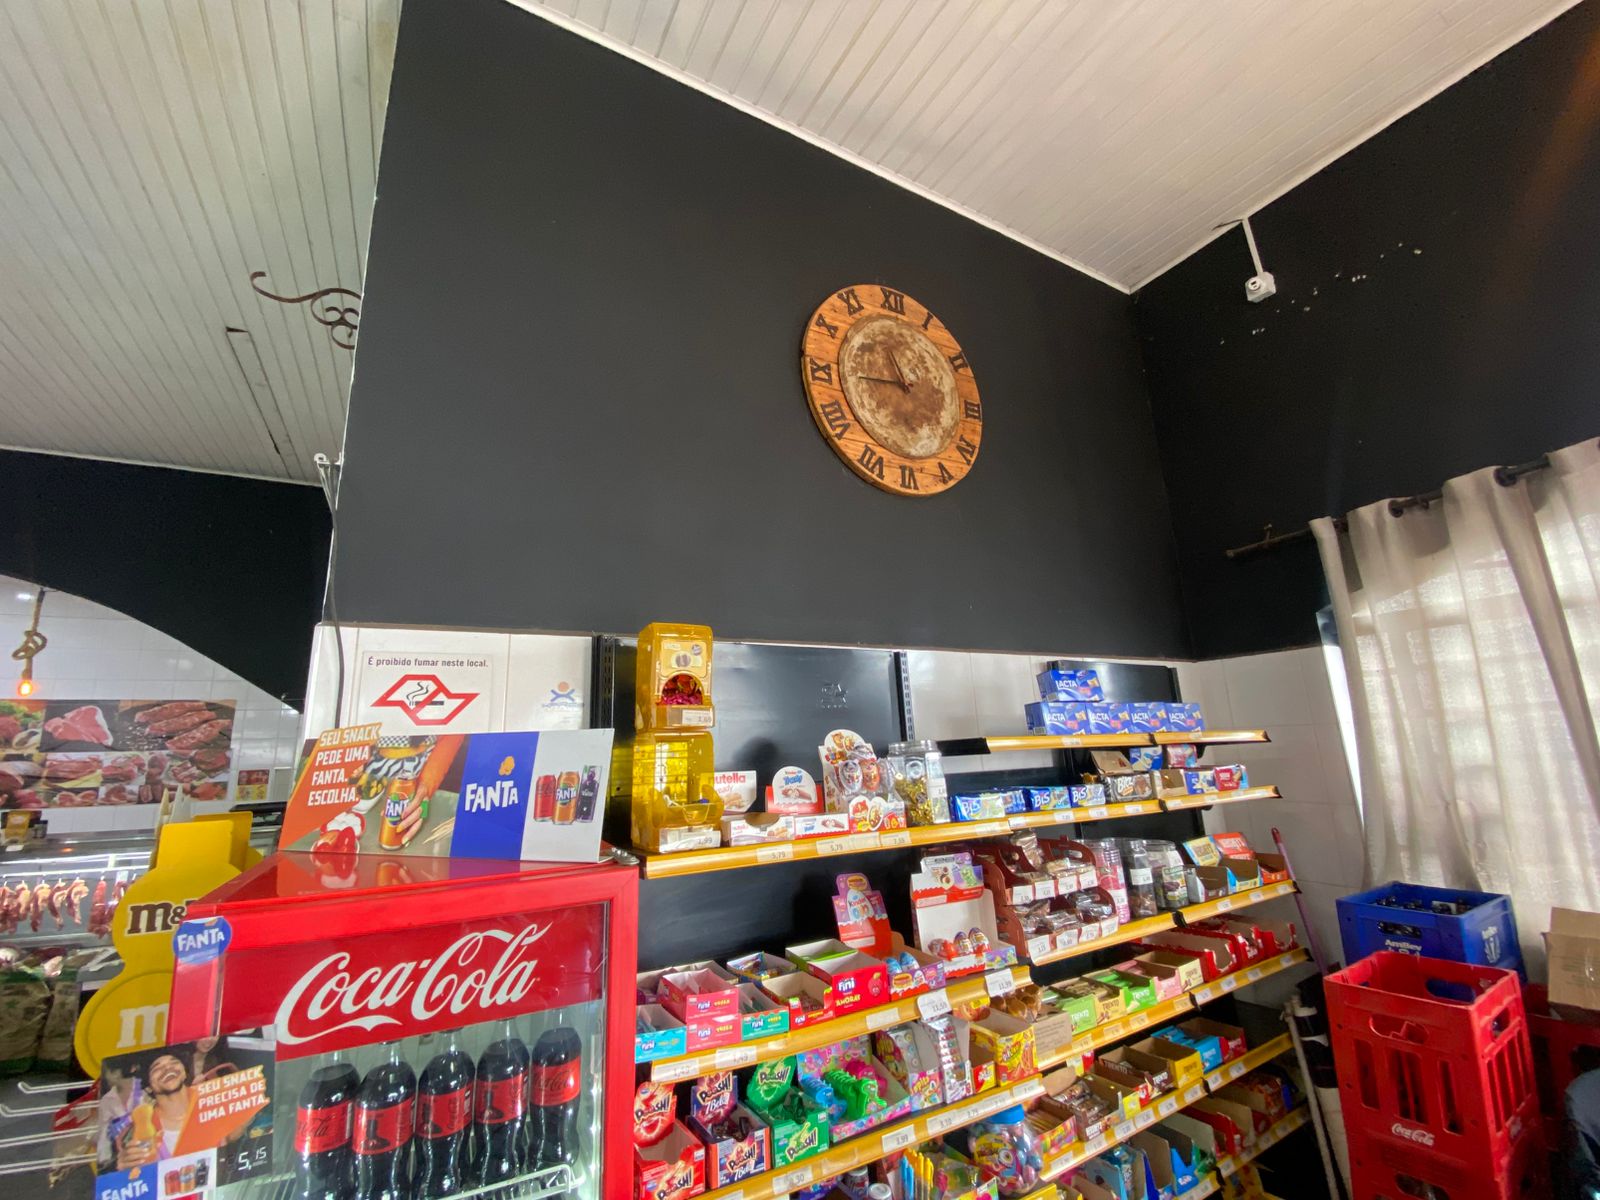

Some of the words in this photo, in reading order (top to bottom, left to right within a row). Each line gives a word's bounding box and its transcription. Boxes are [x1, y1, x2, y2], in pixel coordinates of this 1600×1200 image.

[838, 288, 864, 316] XI
[880, 287, 905, 315] XII
[816, 313, 839, 338] X
[810, 357, 833, 385] IX
[949, 351, 969, 372] II
[857, 444, 885, 481] VII
[937, 461, 954, 485] V
[899, 464, 920, 490] VI
[367, 656, 374, 666] É
[376, 657, 412, 667] proibido
[414, 658, 439, 667] fumar
[441, 659, 465, 668] neste
[467, 659, 489, 668] local.
[1055, 679, 1078, 690] LACTA
[1045, 713, 1066, 722] LACTA
[1090, 712, 1110, 722] LACTA
[1131, 712, 1149, 722] LACTA
[1169, 712, 1186, 722] LACTA
[319, 730, 340, 747] SEU
[342, 725, 380, 745] SNACK
[315, 749, 343, 766] PEDE
[344, 746, 370, 762] UMA
[312, 767, 349, 786] FANTA.
[714, 772, 746, 784] utella
[307, 786, 361, 807] ESCOLHA.
[464, 780, 519, 815] FANTA
[386, 798, 410, 818] FANT
[176, 926, 226, 952] FANTA
[1385, 939, 1422, 952] AmBev
[277, 922, 552, 1046] Coca-Cola
[198, 1079, 221, 1095] SEU
[223, 1066, 263, 1087] SNACK
[198, 1086, 247, 1110] PRECISA
[250, 1081, 266, 1092] DE
[199, 1106, 226, 1123] UMA
[229, 1095, 270, 1114] FANTA.
[1391, 1121, 1434, 1147] Coca-Cola
[101, 1179, 150, 1200] FANTA
